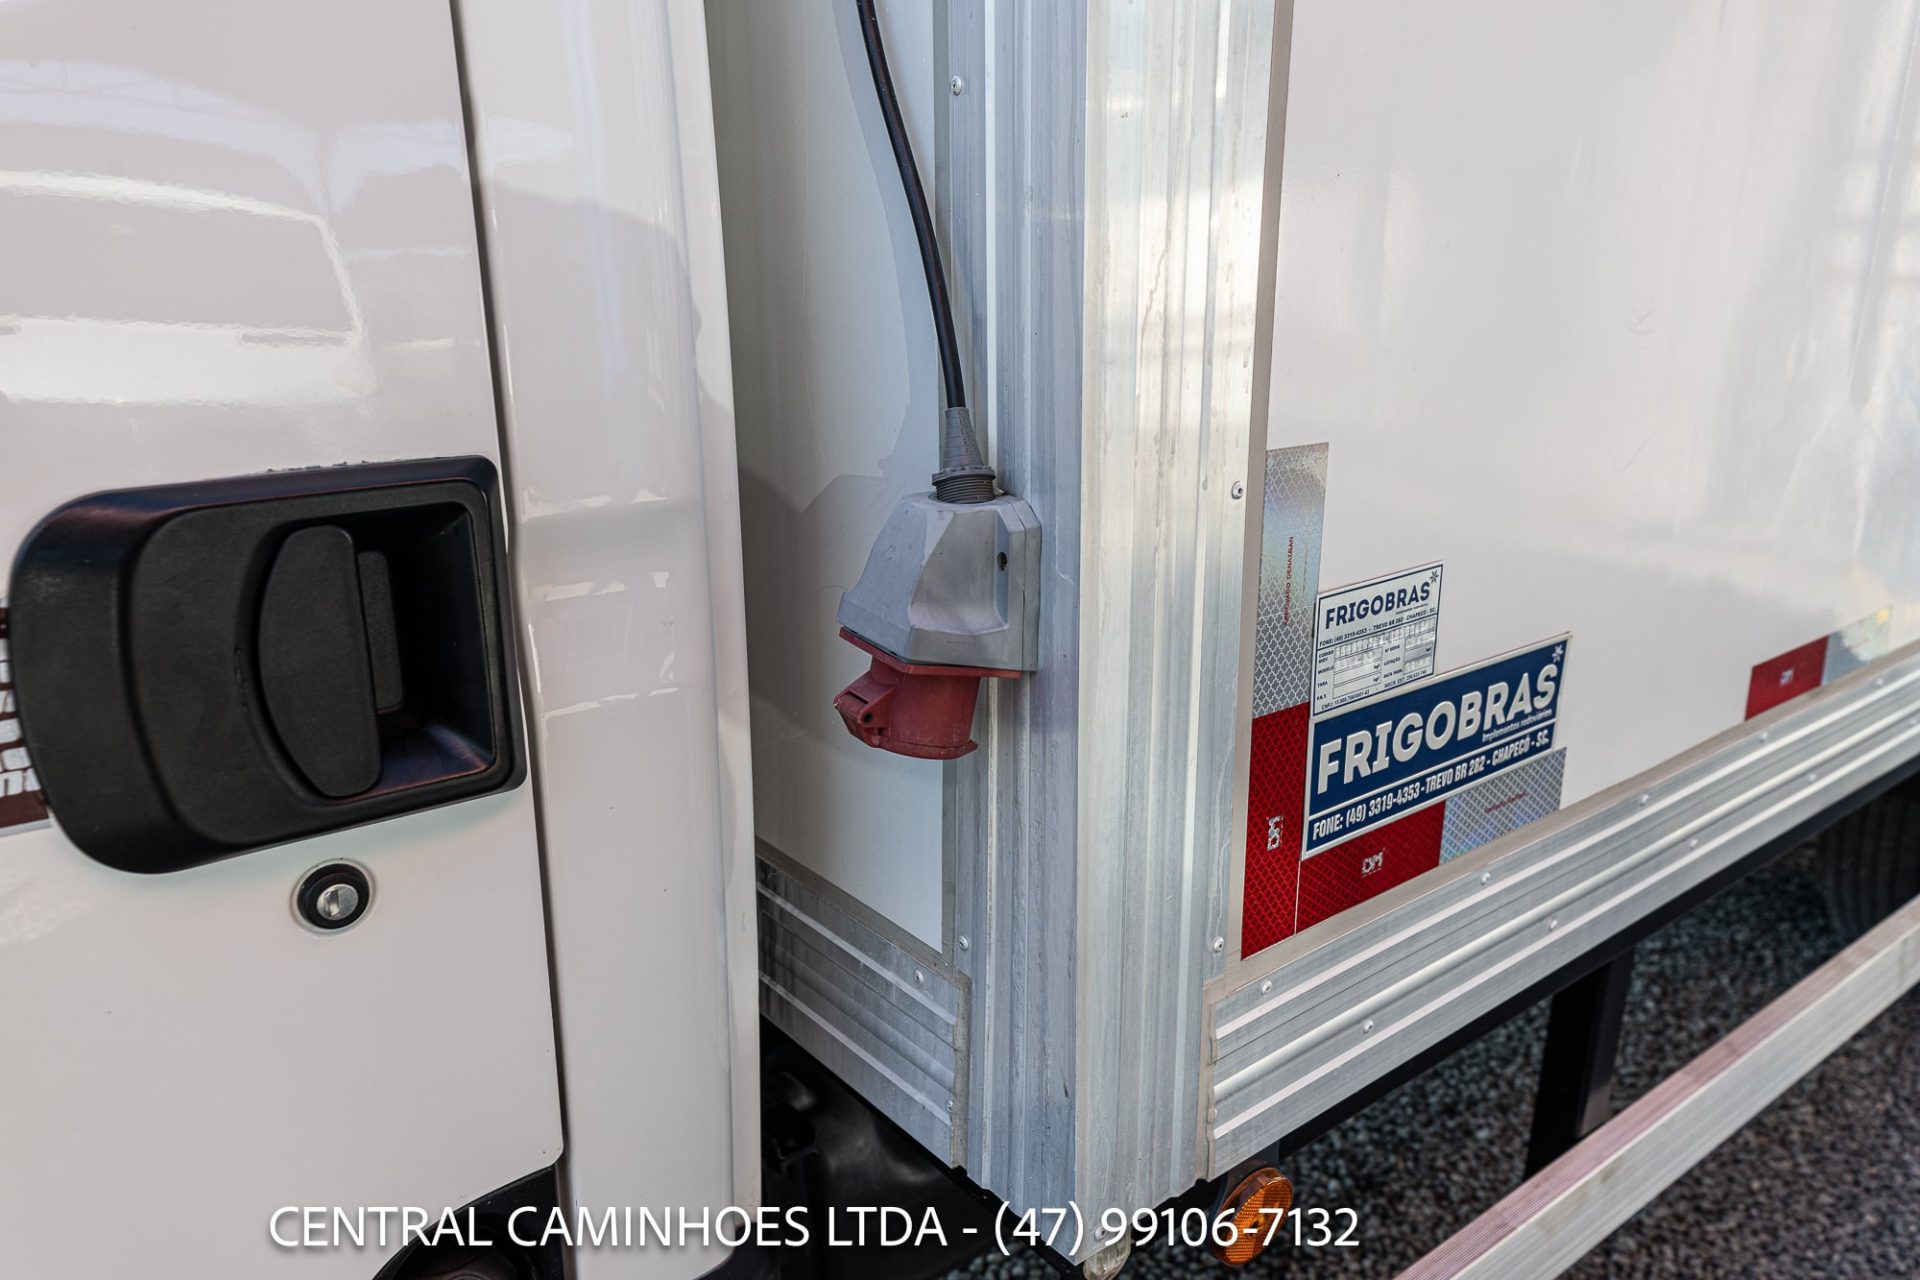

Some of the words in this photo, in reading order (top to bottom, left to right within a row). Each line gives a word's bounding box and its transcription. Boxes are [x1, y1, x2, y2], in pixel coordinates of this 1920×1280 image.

[1286, 537, 1294, 580] DENATRAN
[1325, 581, 1430, 629] FRIGOBRAS
[1319, 638, 1334, 647] FONE:
[1373, 621, 1388, 631] TREVO
[1317, 663, 1558, 795] FRIGOBRAS
[1482, 722, 1520, 743] Implementos
[1312, 813, 1343, 840] FONE:
[1346, 803, 1367, 828] (49)
[1369, 785, 1421, 817] 3319-4353
[1425, 768, 1453, 794] TREVO
[1454, 763, 1468, 782] BR
[1468, 756, 1486, 777] 282
[1492, 735, 1531, 766] CHAPECÓ
